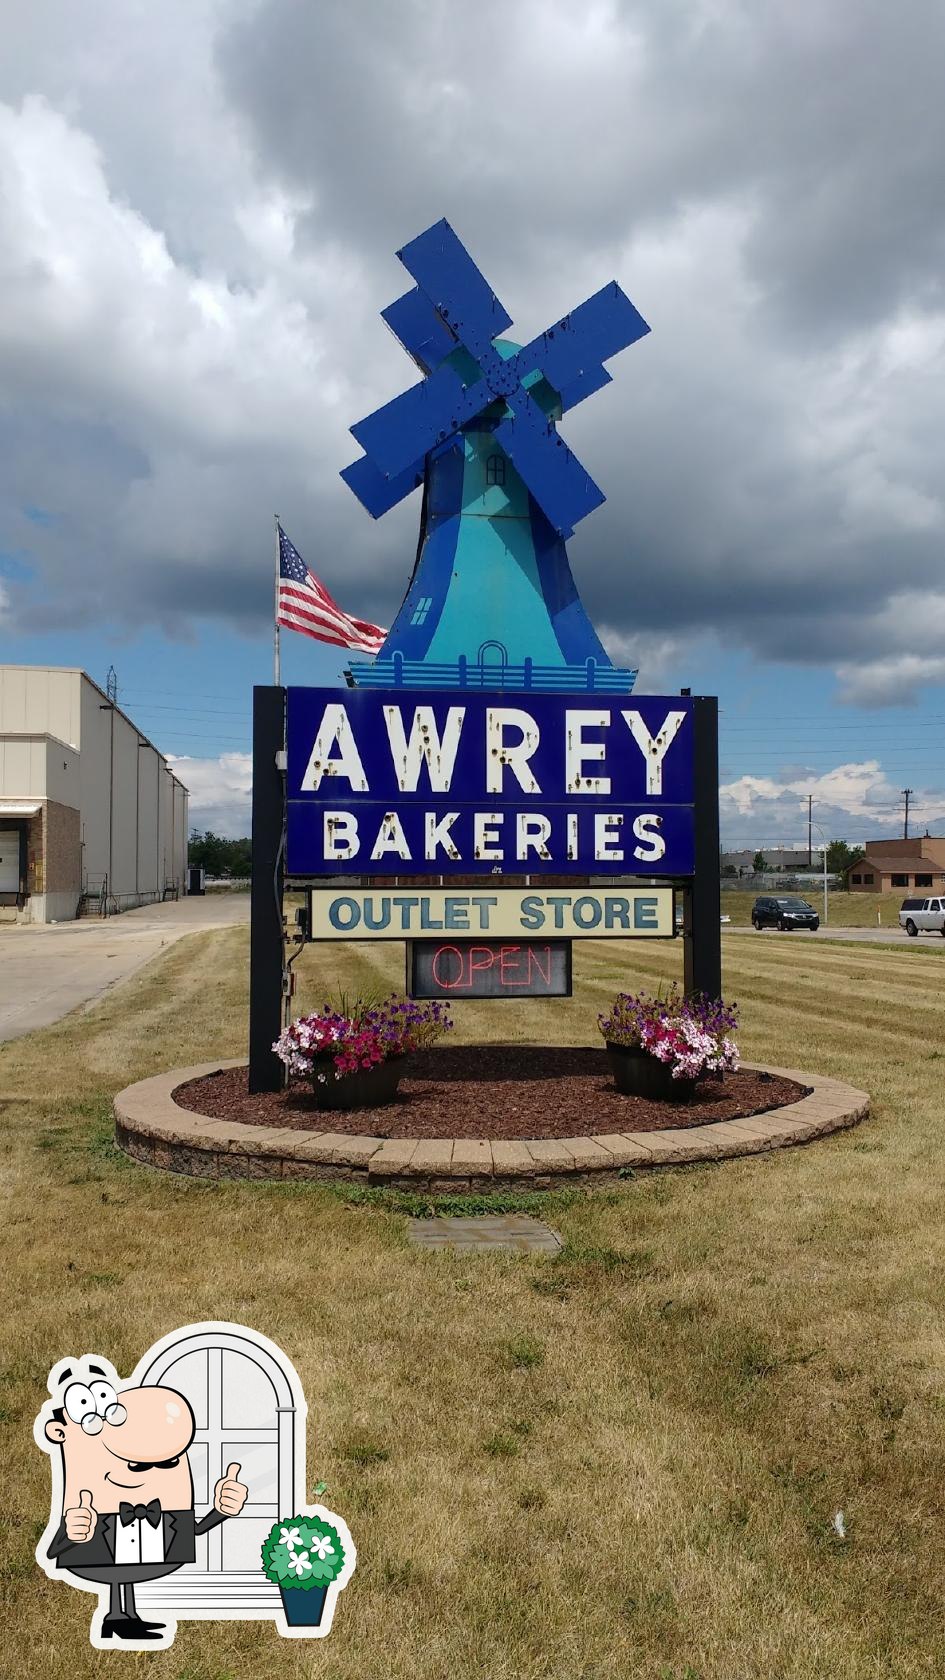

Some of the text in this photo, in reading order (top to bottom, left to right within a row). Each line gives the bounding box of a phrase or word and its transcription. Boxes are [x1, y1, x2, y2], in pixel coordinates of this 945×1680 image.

[301, 703, 687, 795] AWREY
[323, 811, 666, 862] BAKERIES
[329, 896, 659, 931] OUTLET STORE
[432, 945, 551, 988] OPEN
